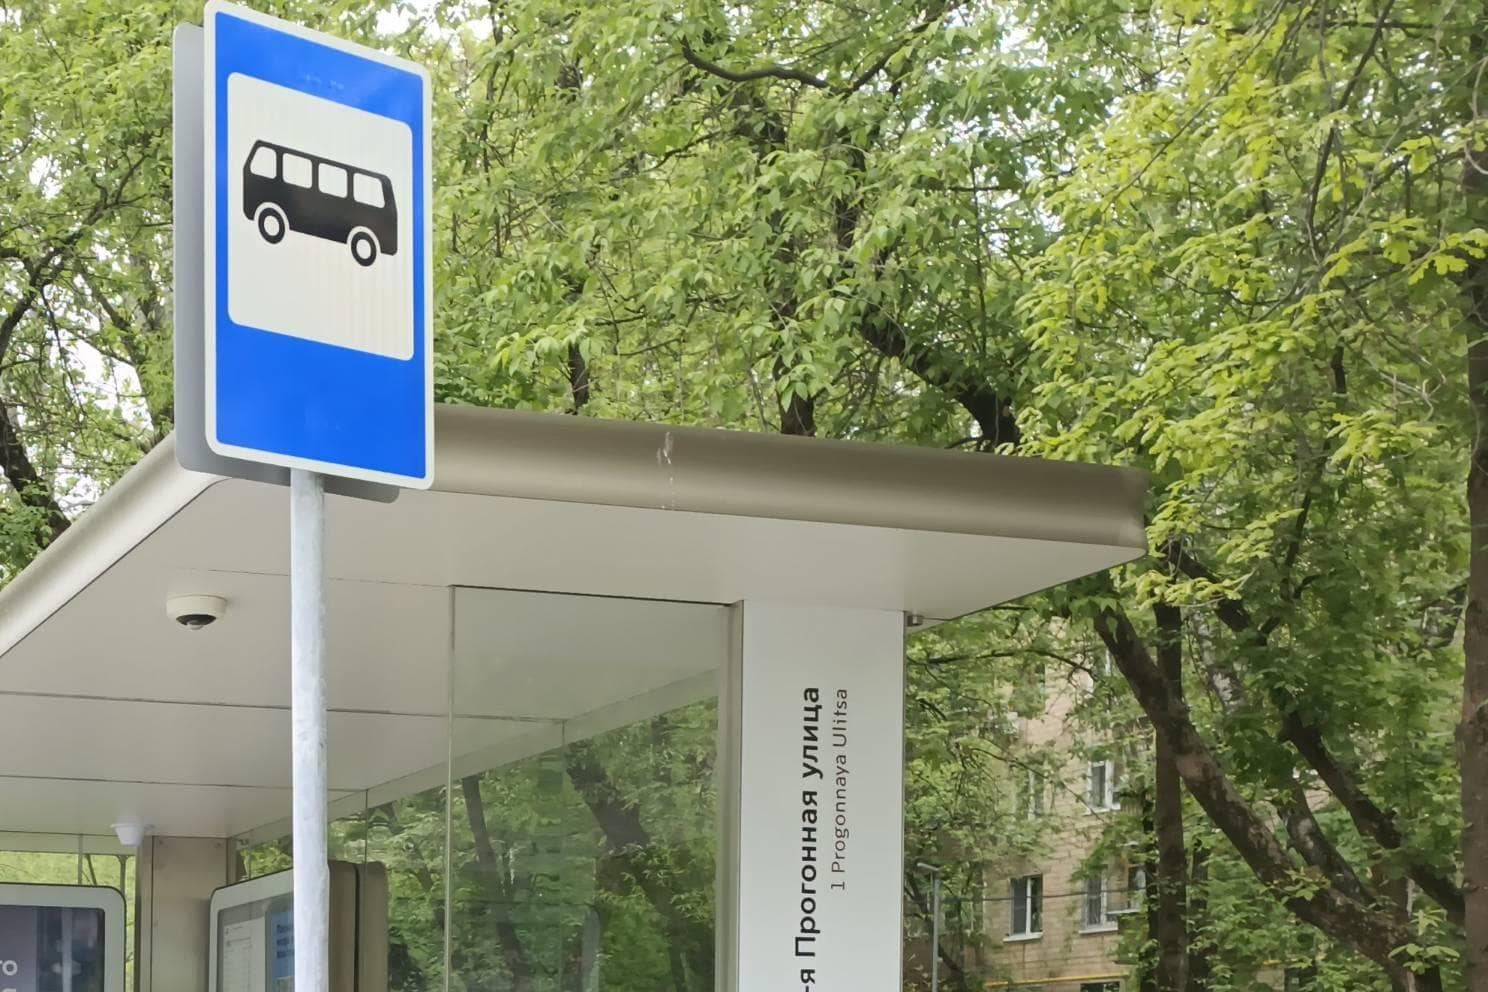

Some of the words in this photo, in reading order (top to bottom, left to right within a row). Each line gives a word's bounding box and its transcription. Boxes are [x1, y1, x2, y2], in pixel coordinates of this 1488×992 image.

[802, 687, 824, 780] улица
[832, 688, 848, 748] Ulitsa
[831, 754, 850, 873] Progonnaya
[795, 790, 821, 957] Прогонная
[830, 881, 846, 891] 1
